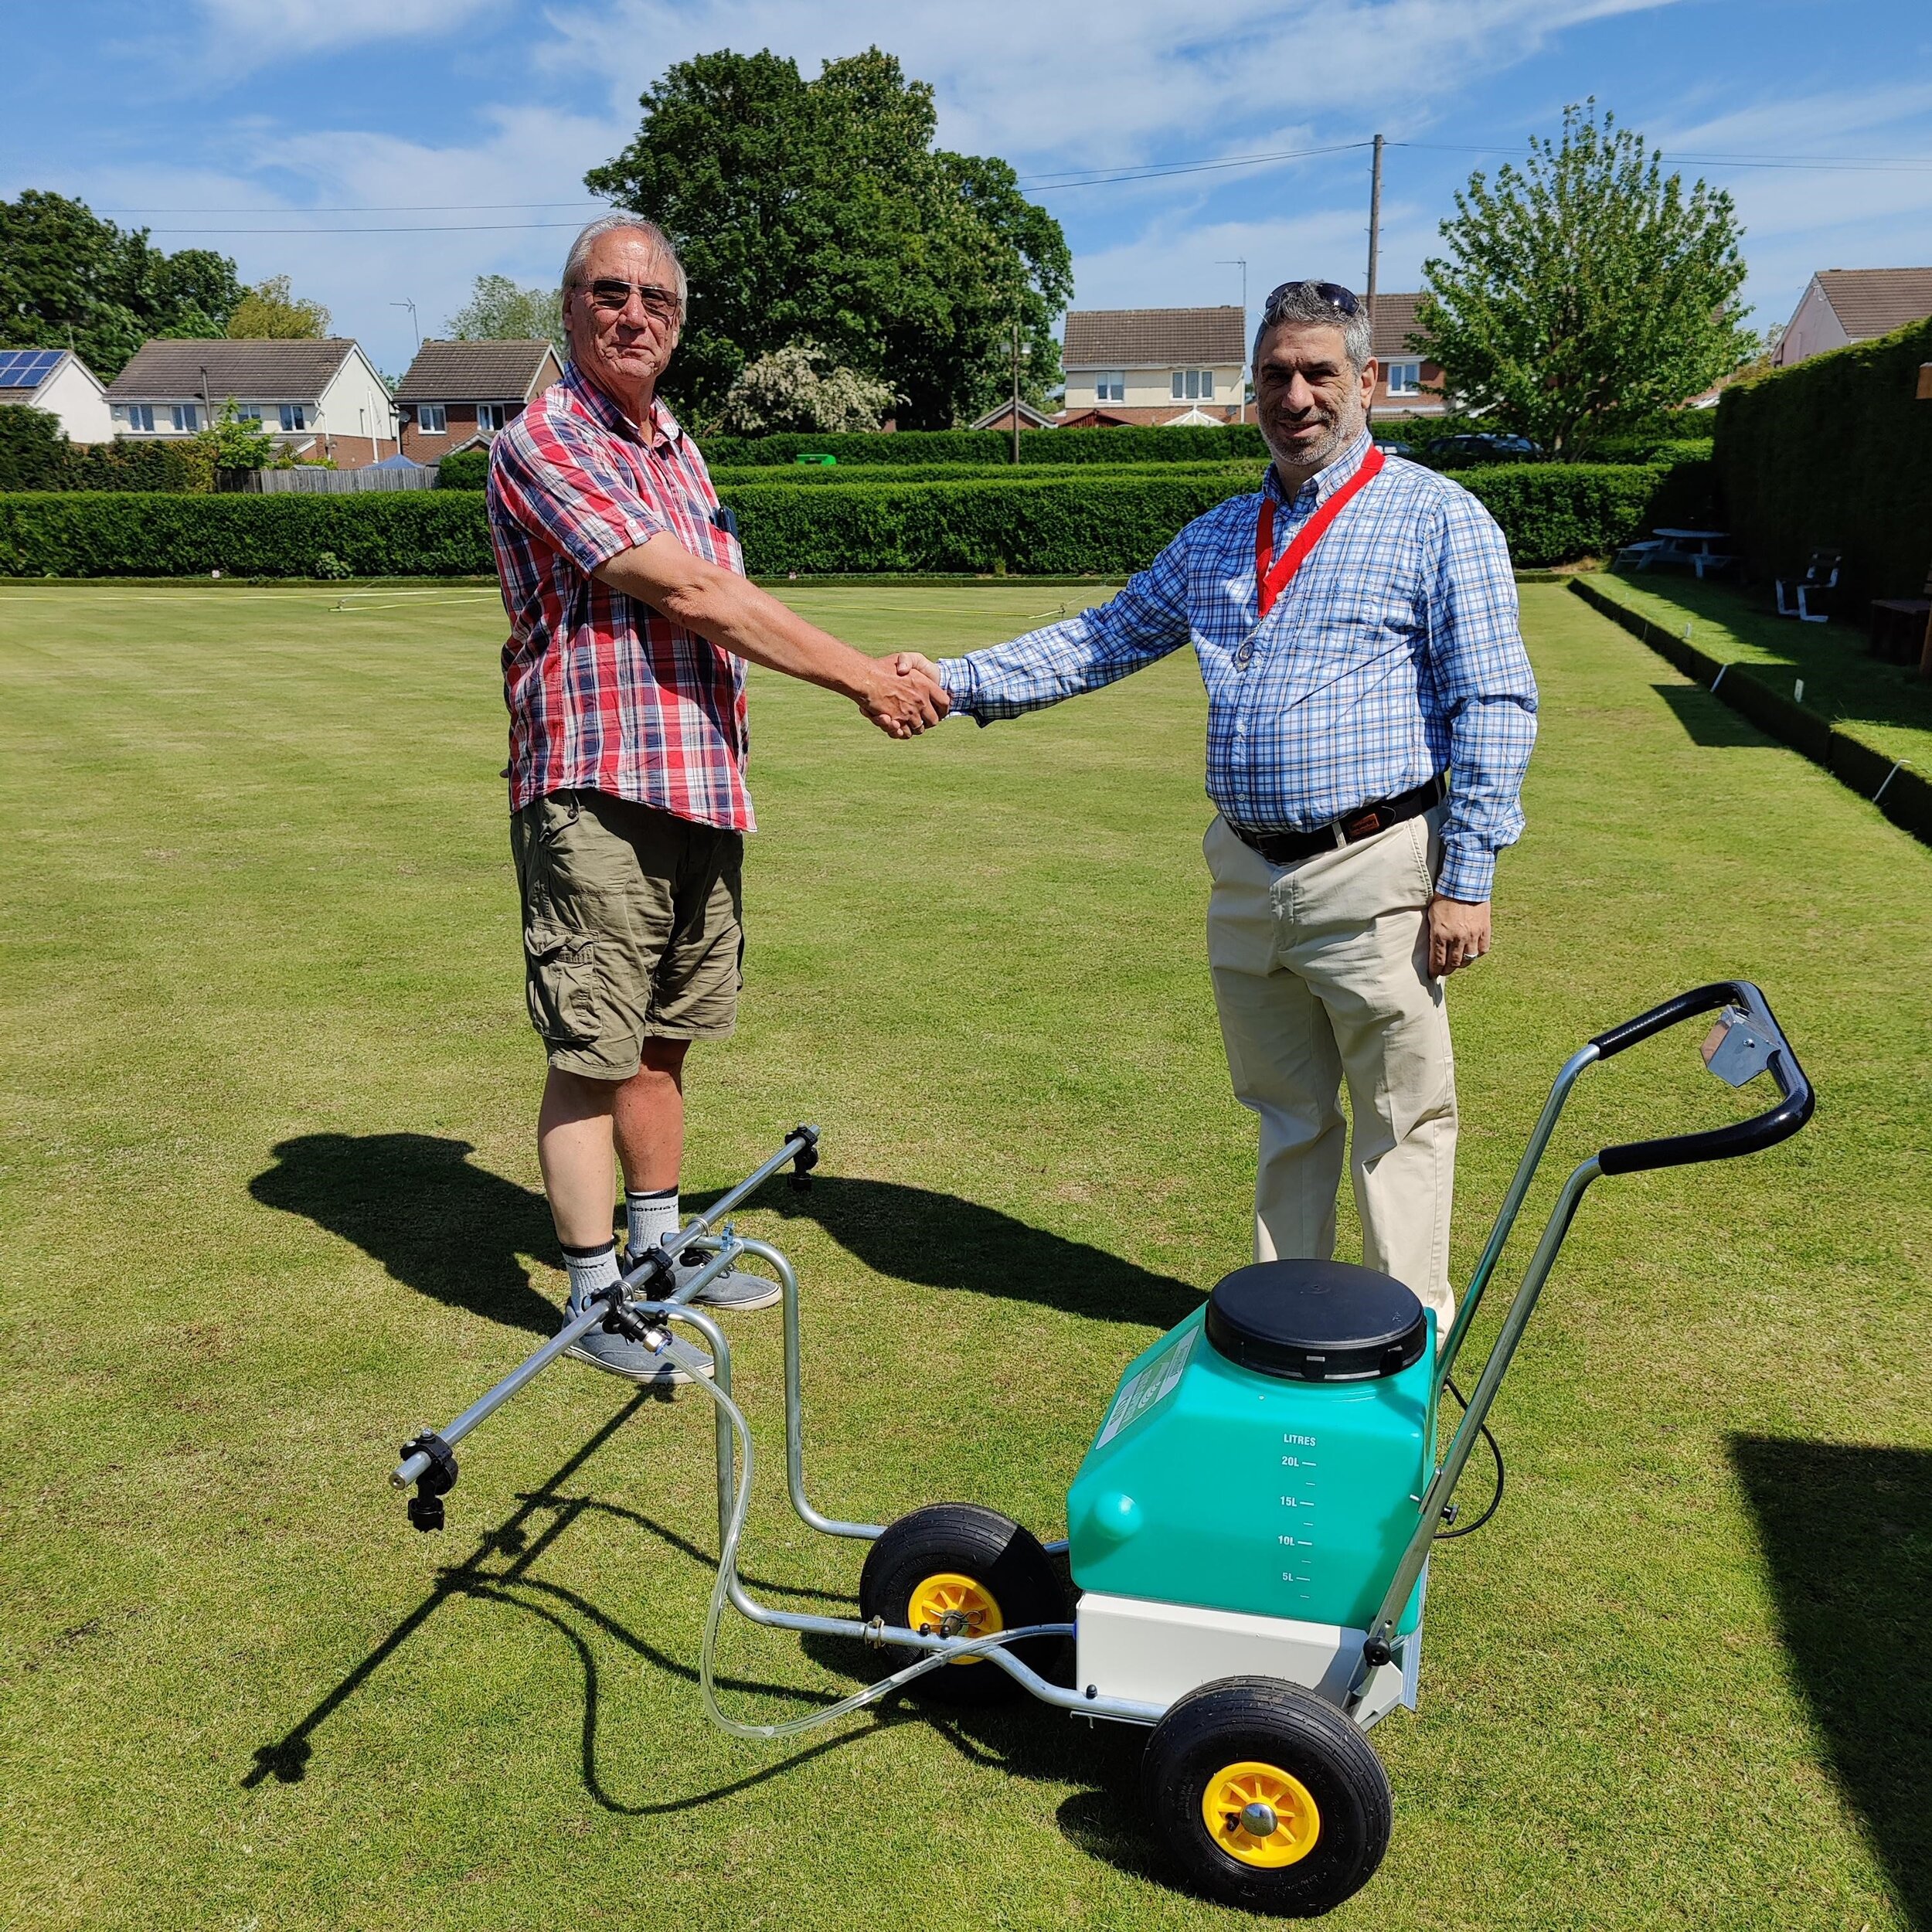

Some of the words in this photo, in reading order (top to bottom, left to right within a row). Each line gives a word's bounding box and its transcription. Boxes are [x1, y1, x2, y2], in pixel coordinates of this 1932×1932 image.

[630, 1203, 677, 1212] DONNAY
[1284, 1434, 1316, 1447] LITRES
[1281, 1456, 1299, 1467] 20L
[1280, 1495, 1298, 1507] 15L
[1277, 1535, 1294, 1546] 10L
[1282, 1572, 1294, 1582] 5L
